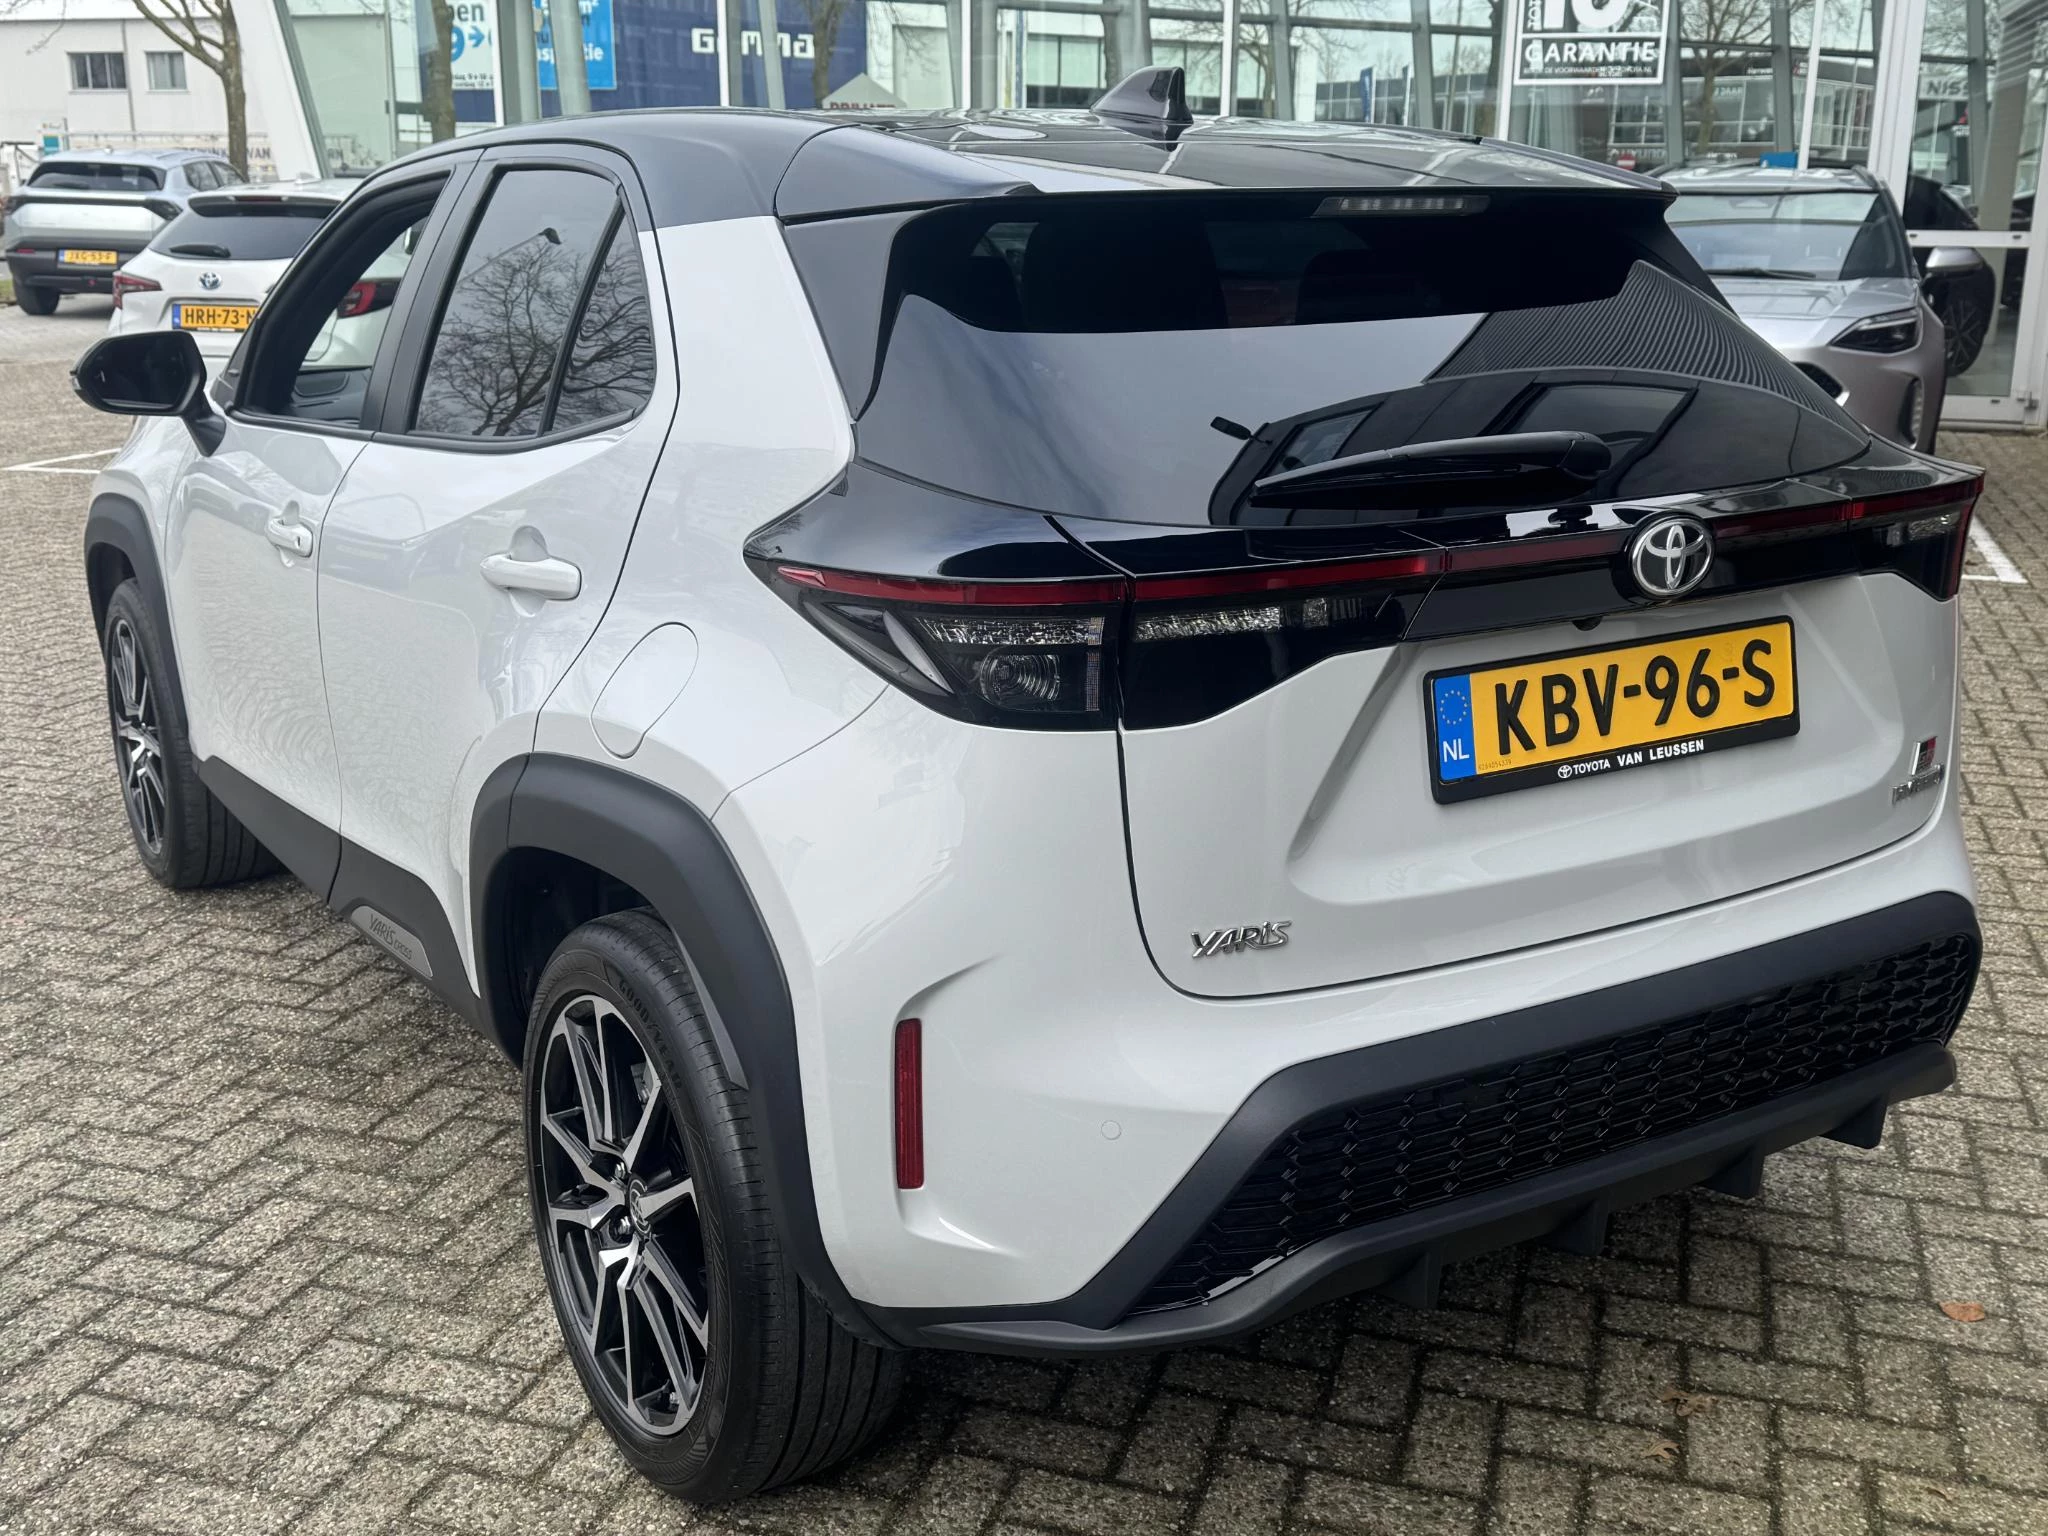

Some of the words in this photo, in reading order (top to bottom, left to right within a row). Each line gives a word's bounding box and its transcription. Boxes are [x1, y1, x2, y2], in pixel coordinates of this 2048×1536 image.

[1525, 41, 1656, 63] GARANTIE
[1495, 639, 1775, 755] KBV-96-S
[1443, 740, 1470, 763] NL
[1573, 759, 1610, 775] TOYOTA
[1617, 750, 1643, 767] VAN
[1649, 739, 1704, 761] LEUSSEN
